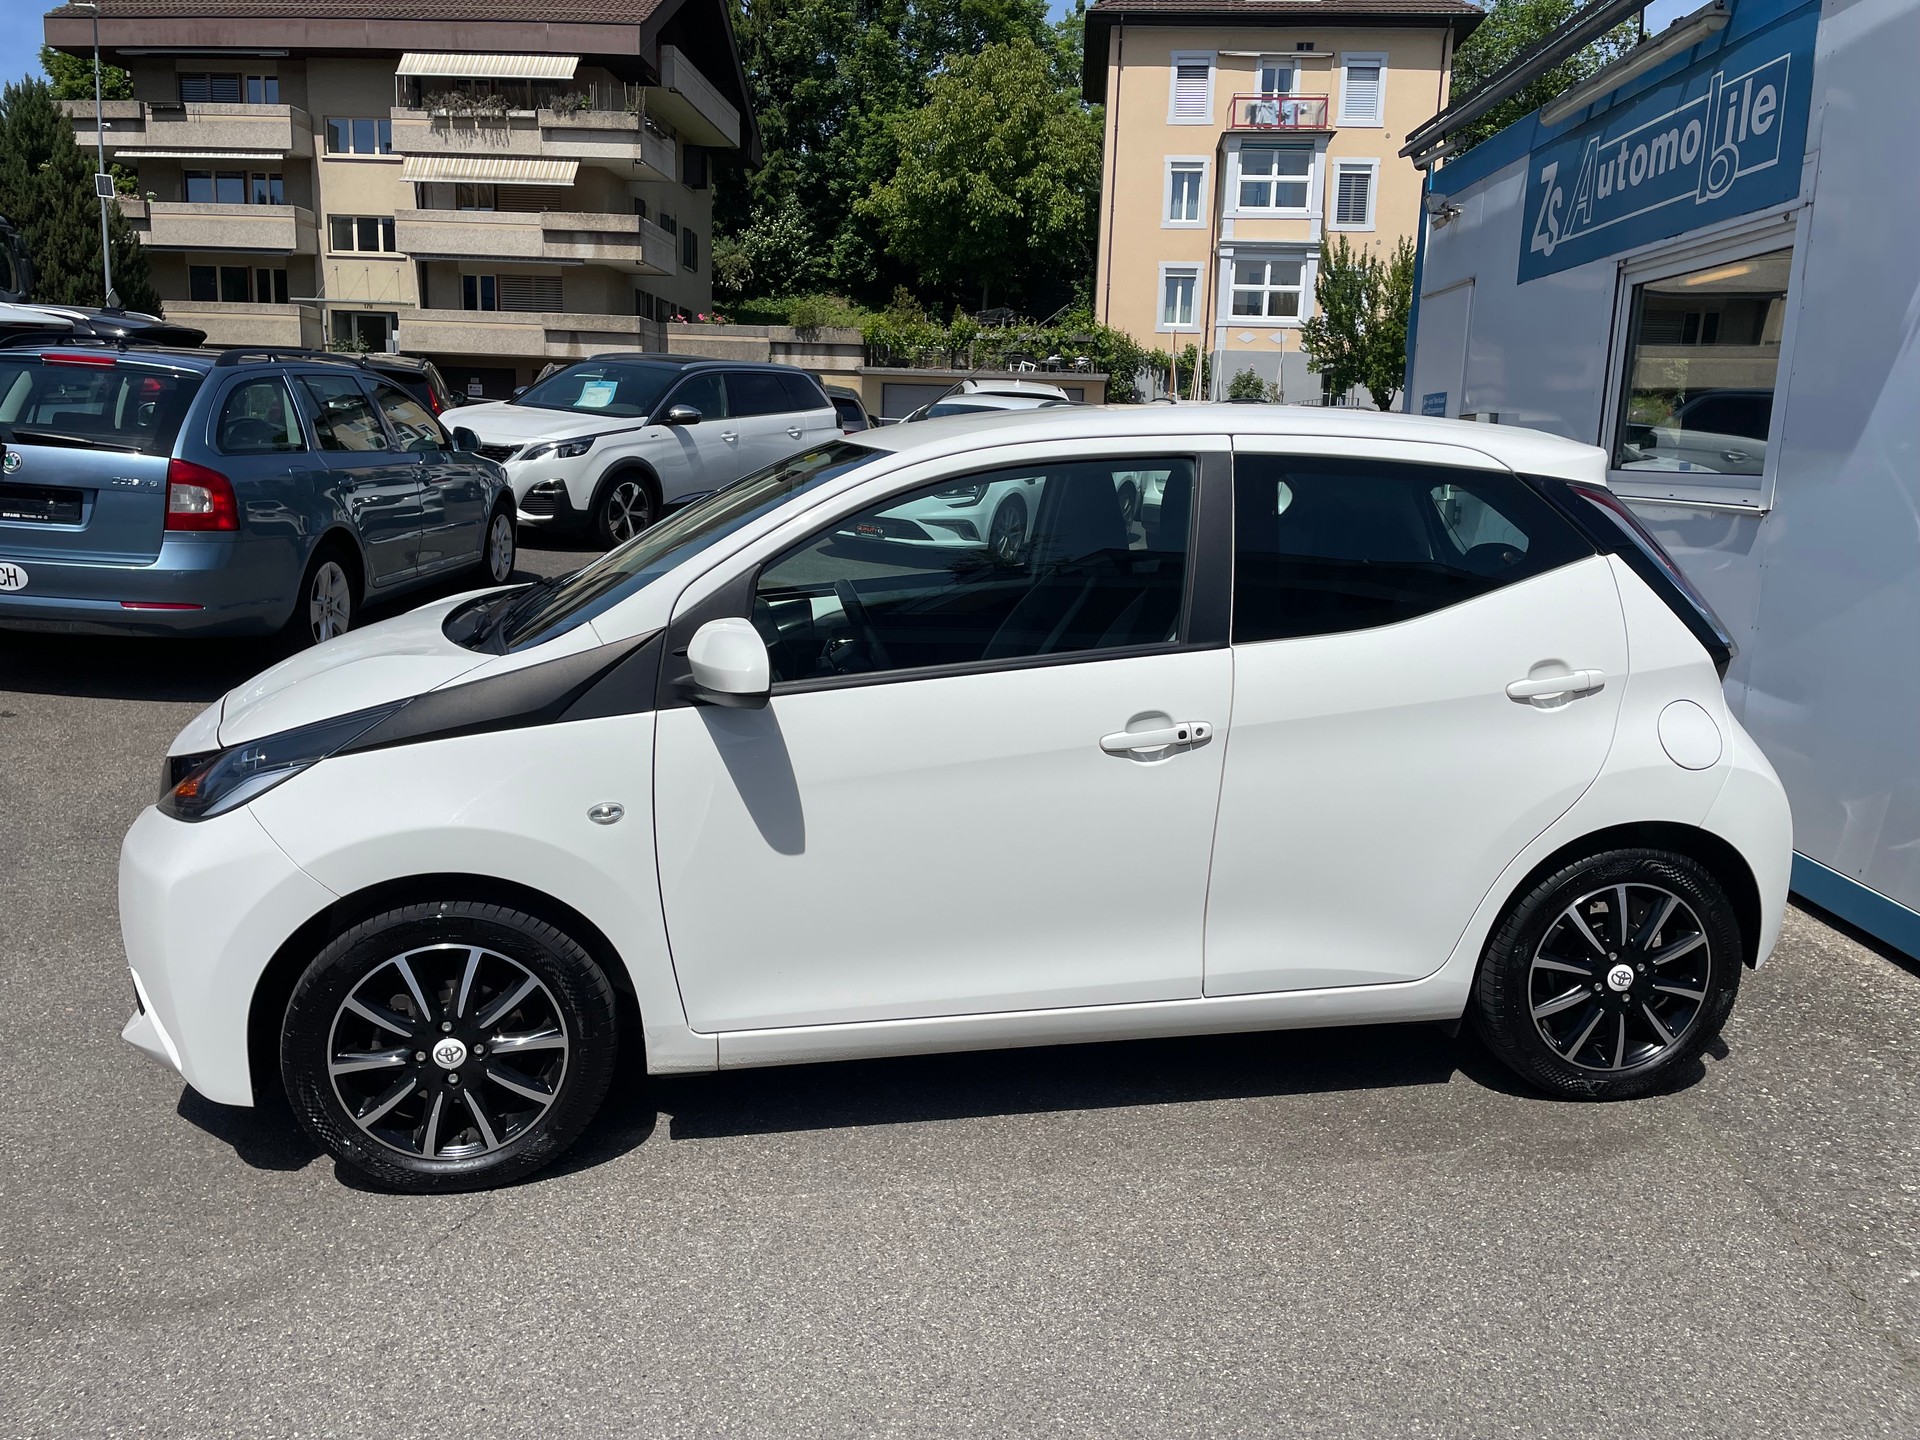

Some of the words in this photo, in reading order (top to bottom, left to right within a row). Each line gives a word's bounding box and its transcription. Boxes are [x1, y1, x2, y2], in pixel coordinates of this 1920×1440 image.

[1530, 161, 1563, 257] Zs
[1561, 70, 1777, 241] Automobile
[0, 567, 19, 586] CH
